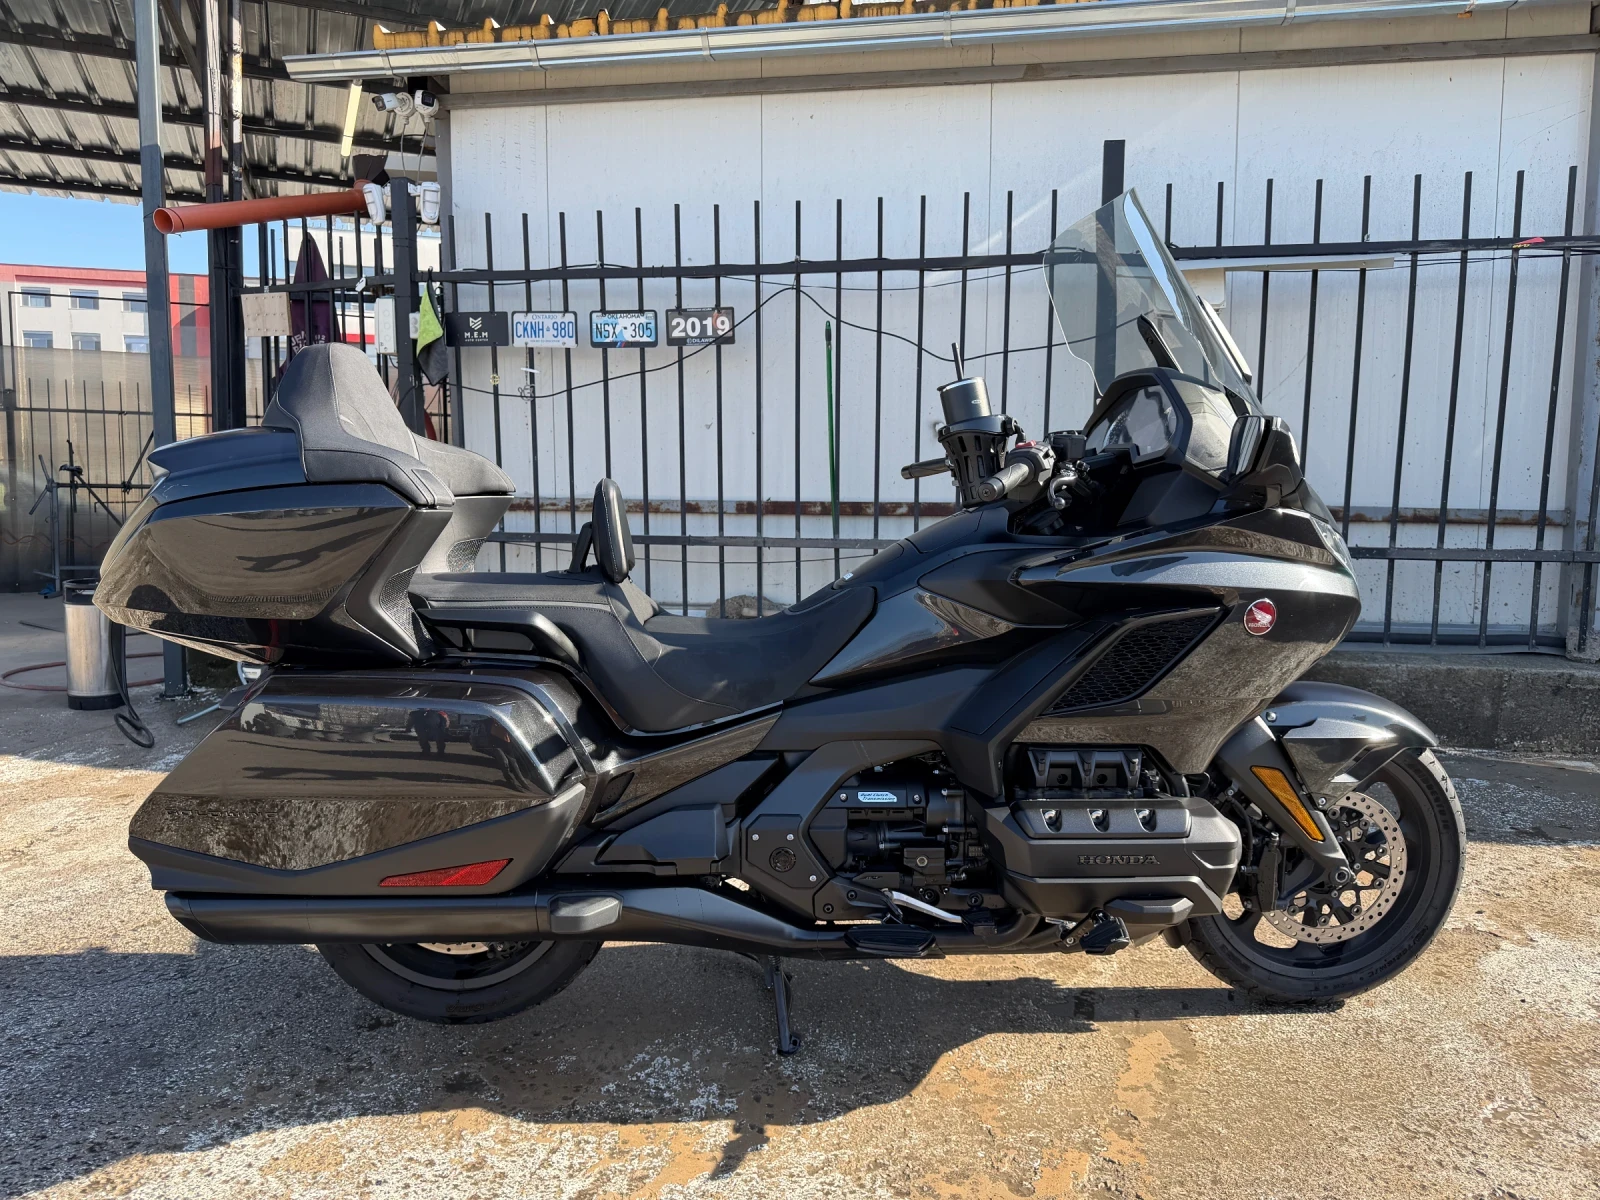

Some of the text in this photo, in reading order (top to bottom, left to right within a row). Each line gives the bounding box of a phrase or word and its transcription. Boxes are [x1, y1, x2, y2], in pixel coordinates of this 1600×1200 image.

[515, 321, 574, 339] CKNH 980
[595, 322, 653, 339] NSX 305
[671, 316, 730, 337] 2019
[1078, 855, 1161, 865] HONDA
